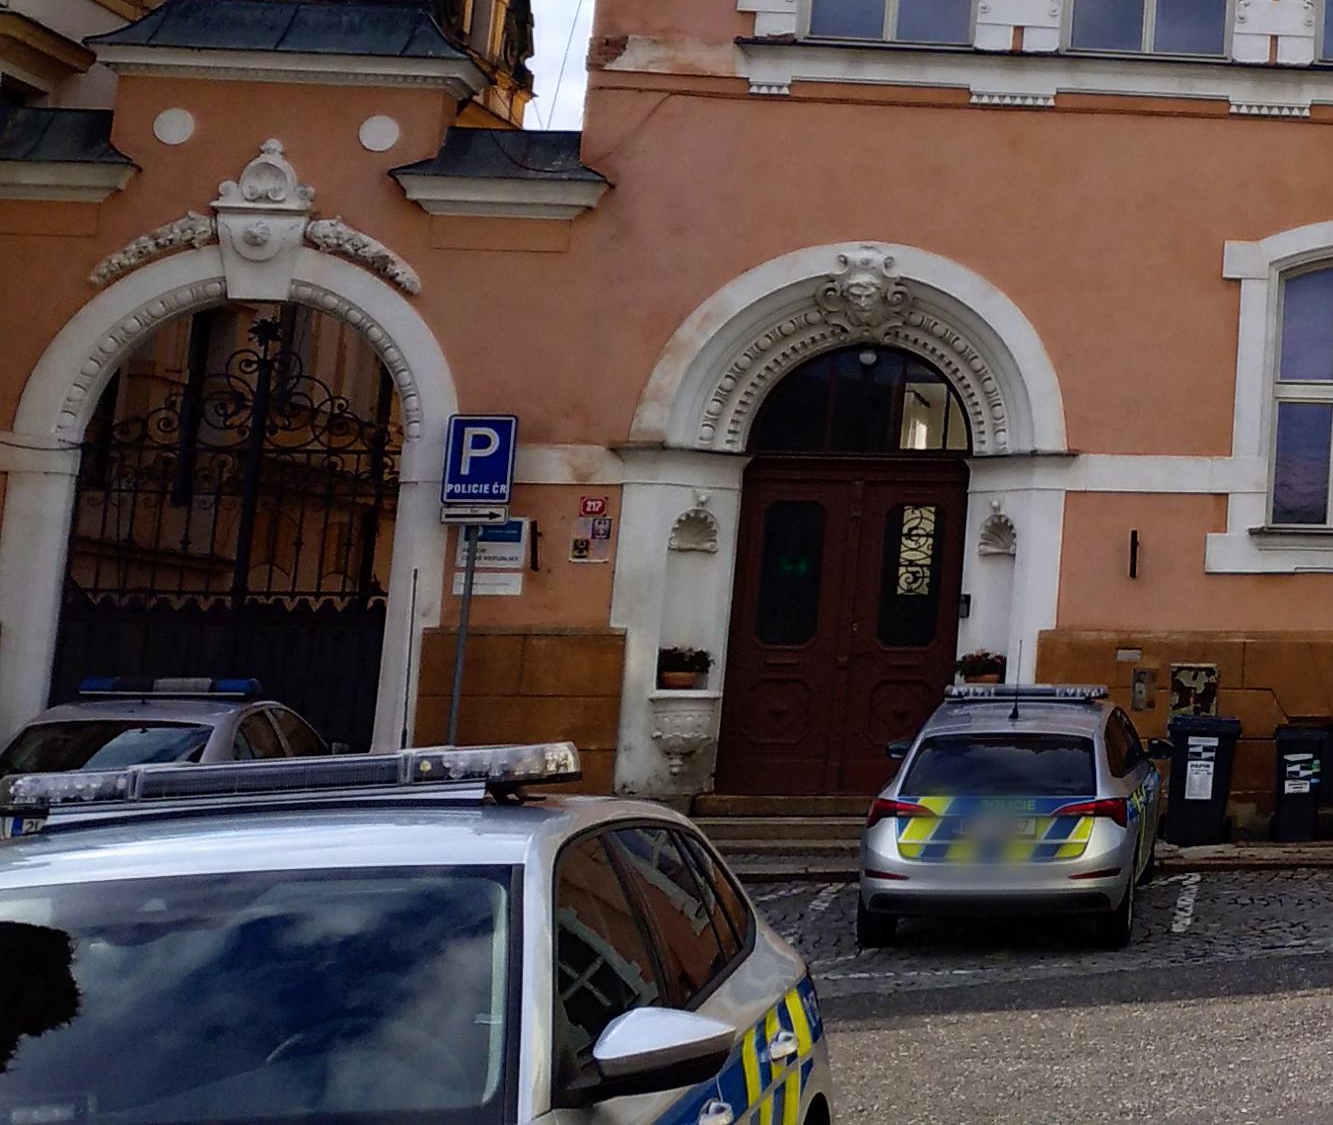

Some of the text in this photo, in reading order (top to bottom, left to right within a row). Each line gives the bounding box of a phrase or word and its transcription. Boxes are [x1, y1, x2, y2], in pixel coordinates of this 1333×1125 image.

[460, 427, 500, 475] P
[447, 482, 507, 494] POLICIE ČR
[586, 501, 602, 512] 217
[981, 800, 1036, 811] POLICIE
